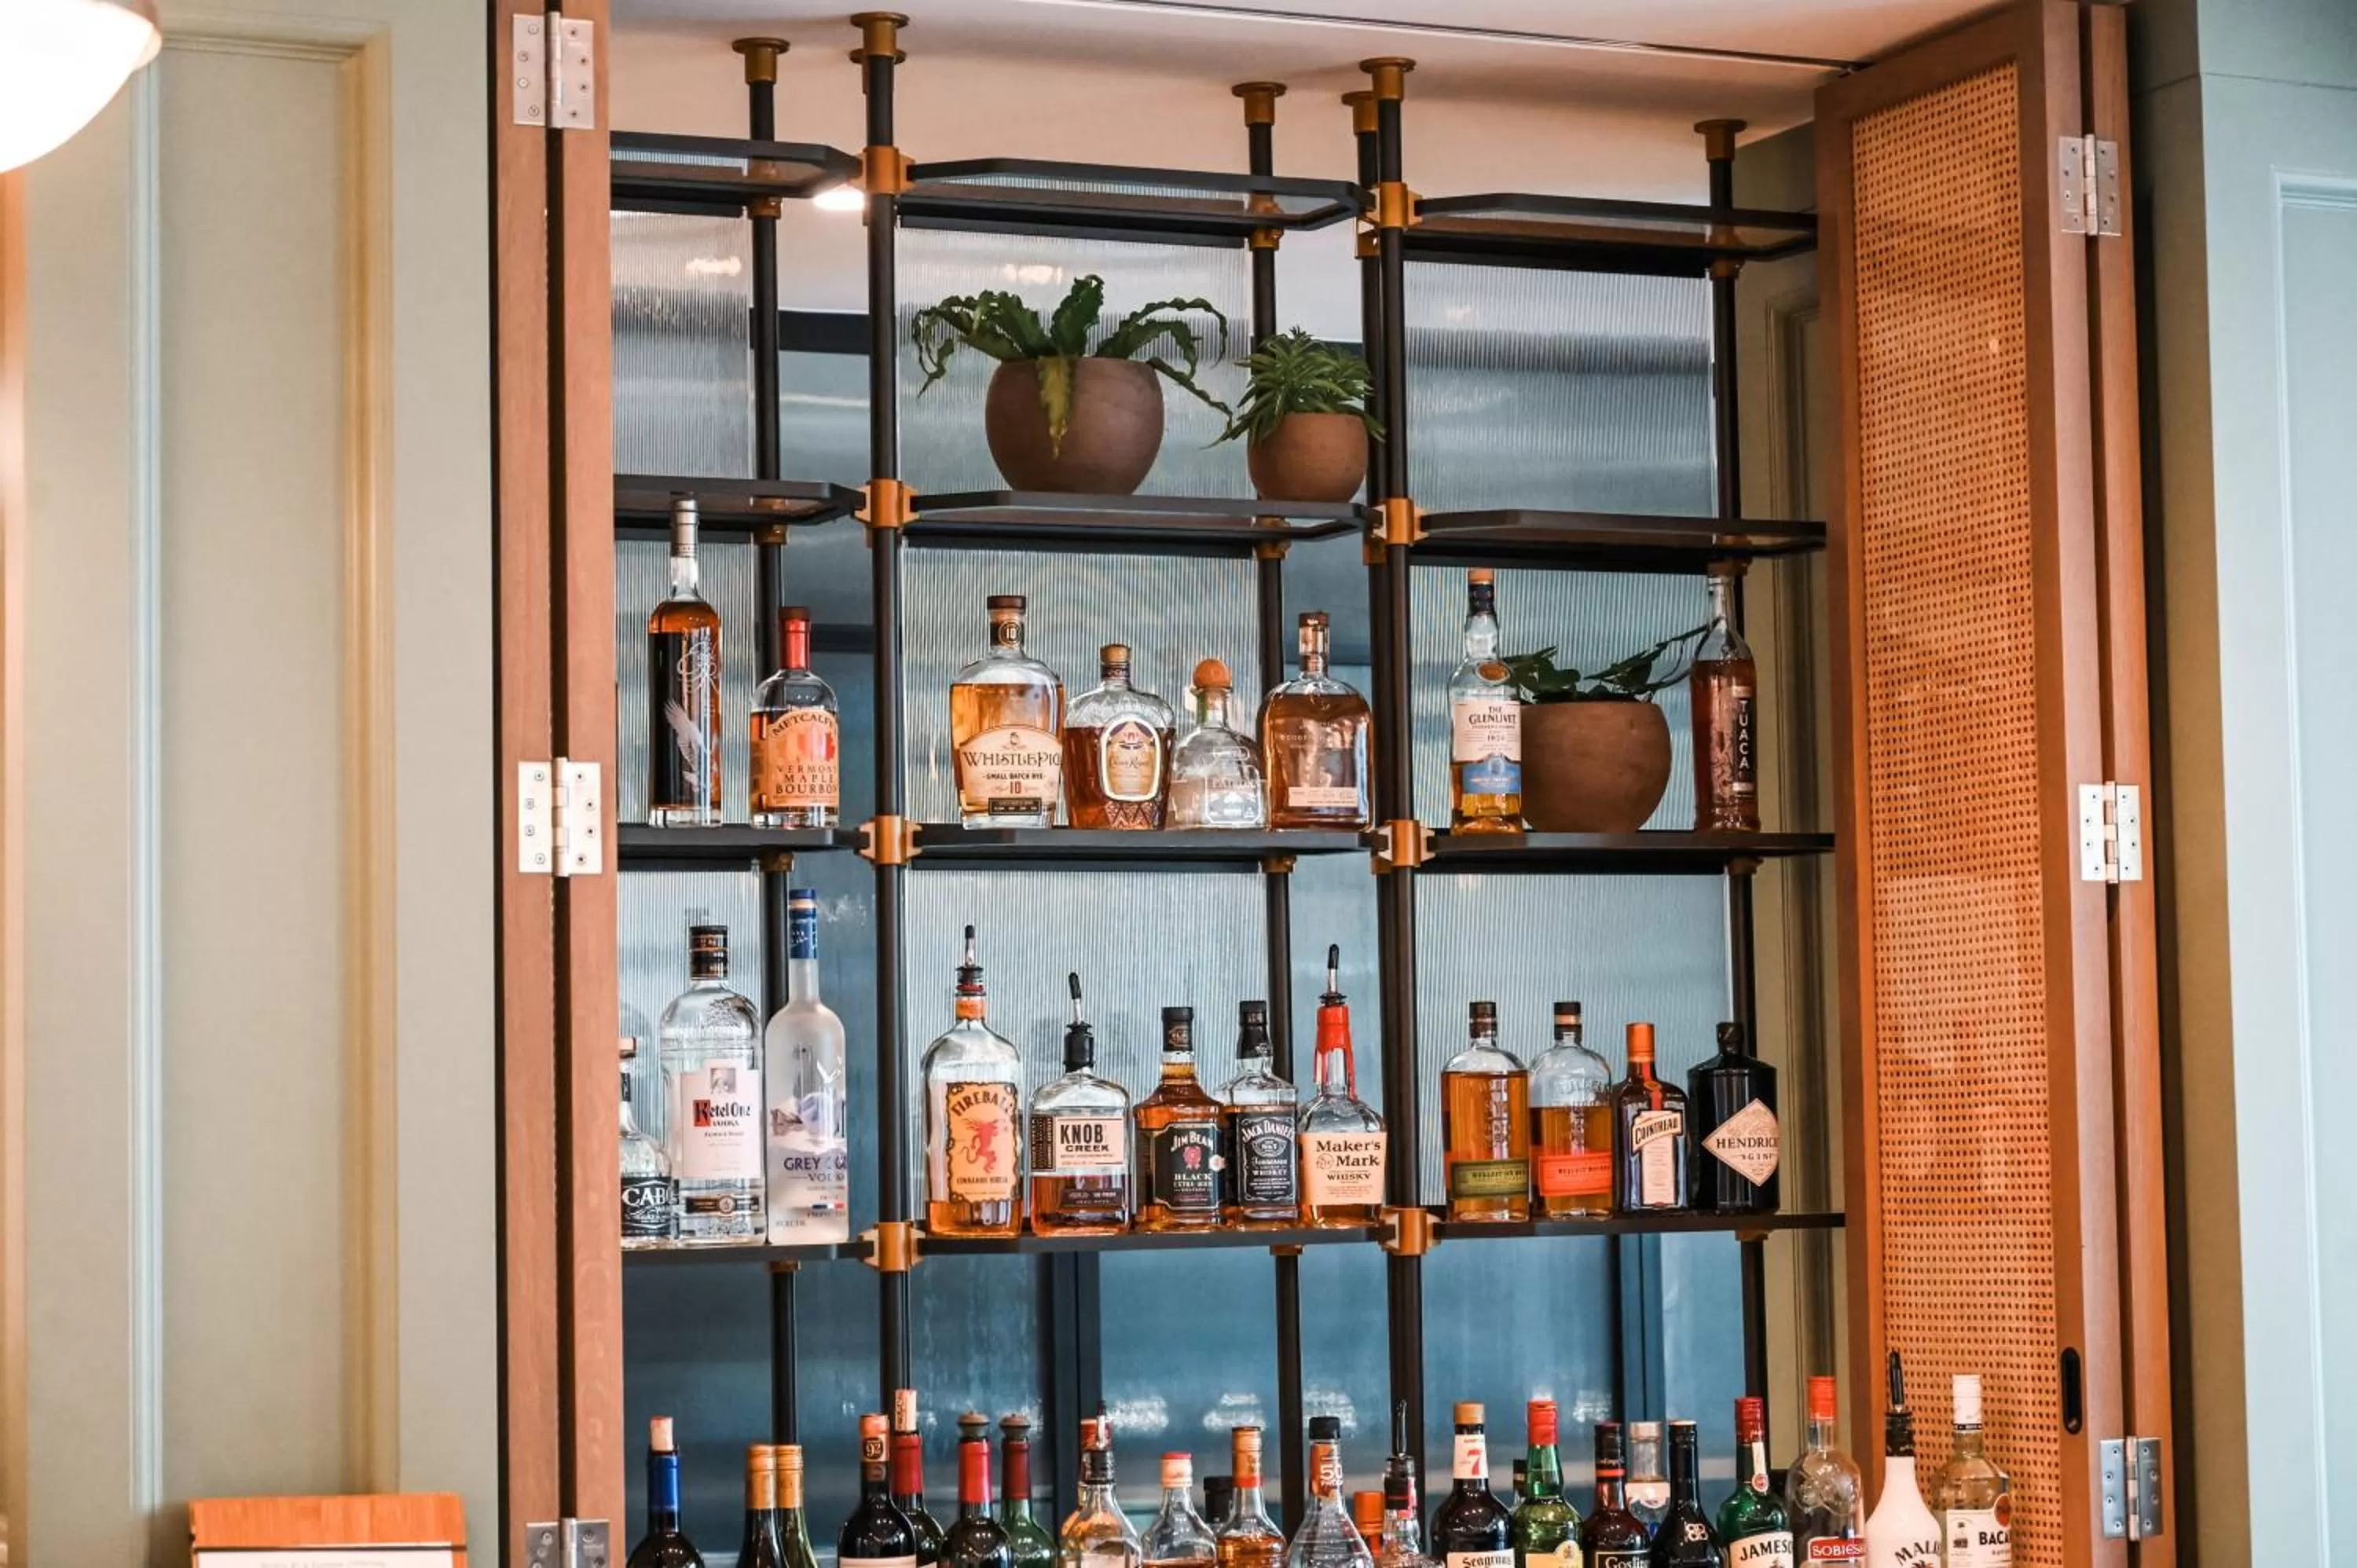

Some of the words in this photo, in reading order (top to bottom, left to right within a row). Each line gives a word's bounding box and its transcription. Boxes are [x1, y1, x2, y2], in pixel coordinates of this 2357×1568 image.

[1468, 713, 1516, 724] GLENLIVET
[1738, 699, 1750, 769] TUACA
[785, 774, 833, 782] MAPLE
[1010, 781, 1021, 794] 10
[695, 1101, 729, 1123] Ketel
[731, 1101, 751, 1117] One
[1060, 1123, 1103, 1145] KNOB
[1170, 1134, 1188, 1152] JIM
[1316, 1140, 1381, 1152] Maker's
[784, 1156, 820, 1171] GREY
[1336, 1154, 1380, 1167] Mark
[1467, 1449, 1483, 1475] 7
